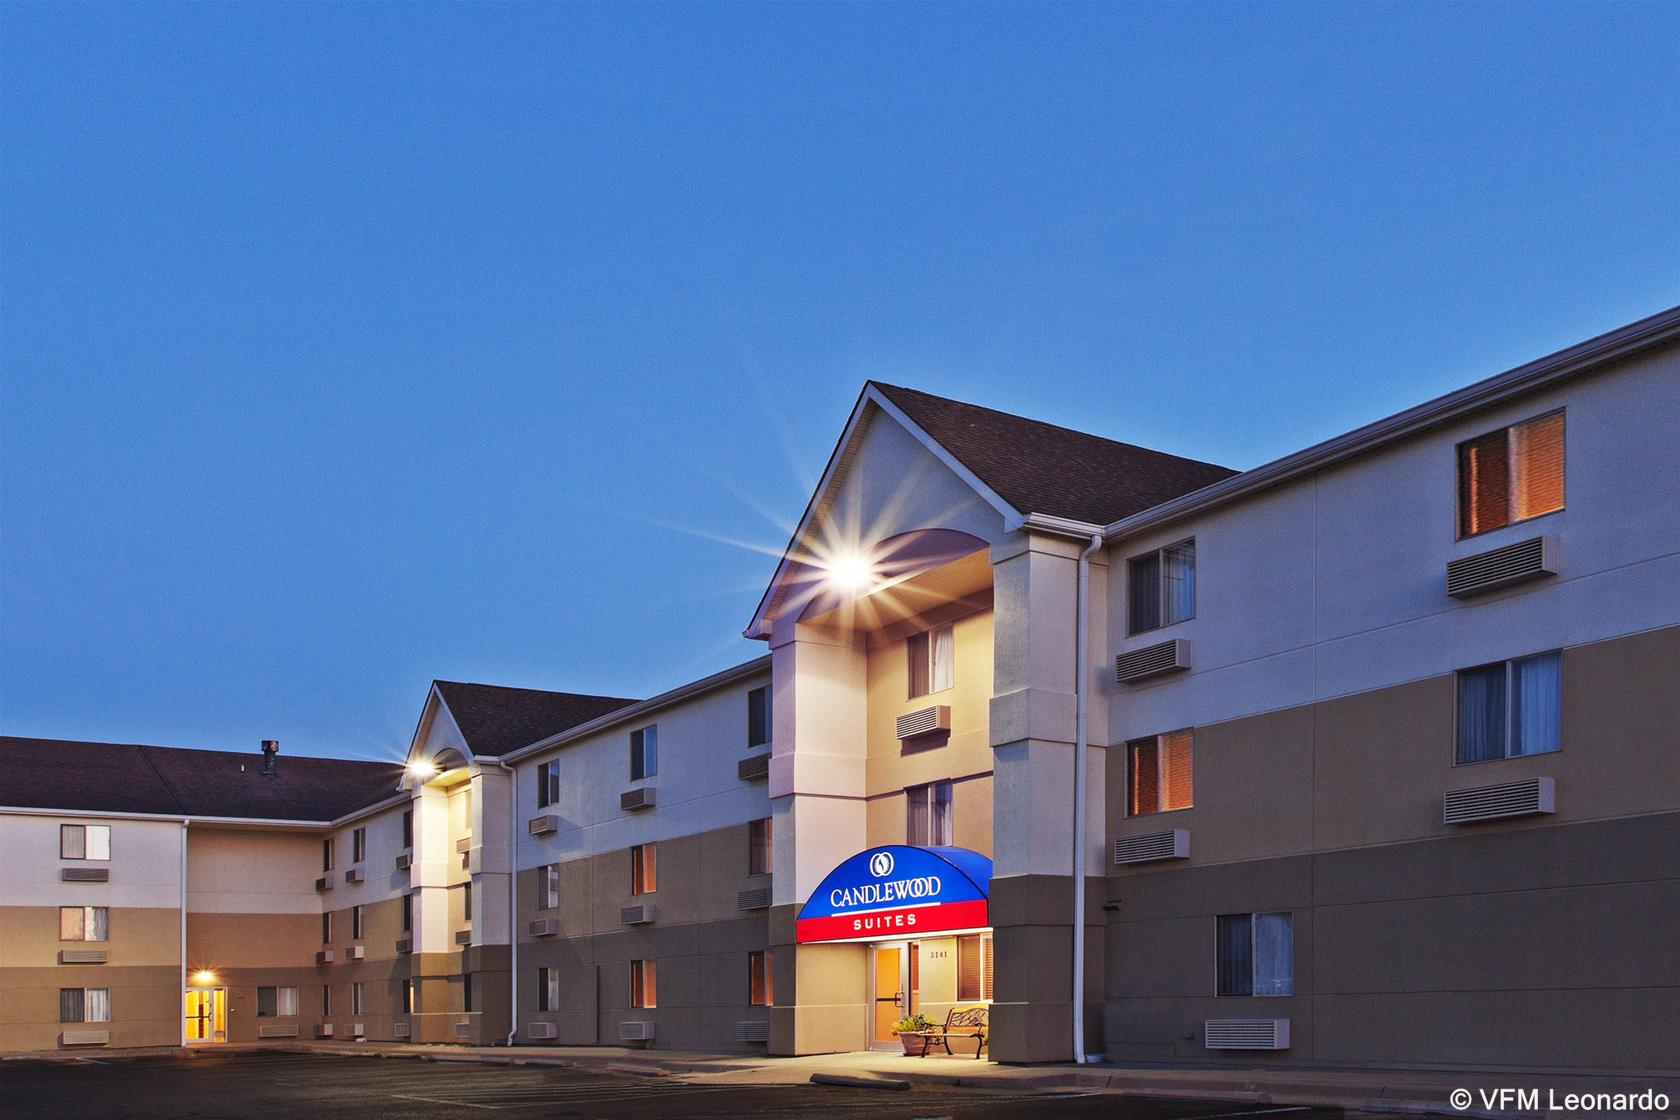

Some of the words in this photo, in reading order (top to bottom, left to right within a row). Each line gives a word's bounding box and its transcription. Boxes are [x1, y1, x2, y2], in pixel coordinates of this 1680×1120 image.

[830, 876, 941, 907] CANDLEWOOD
[853, 914, 917, 930] SUITES
[930, 951, 948, 959] 5141
